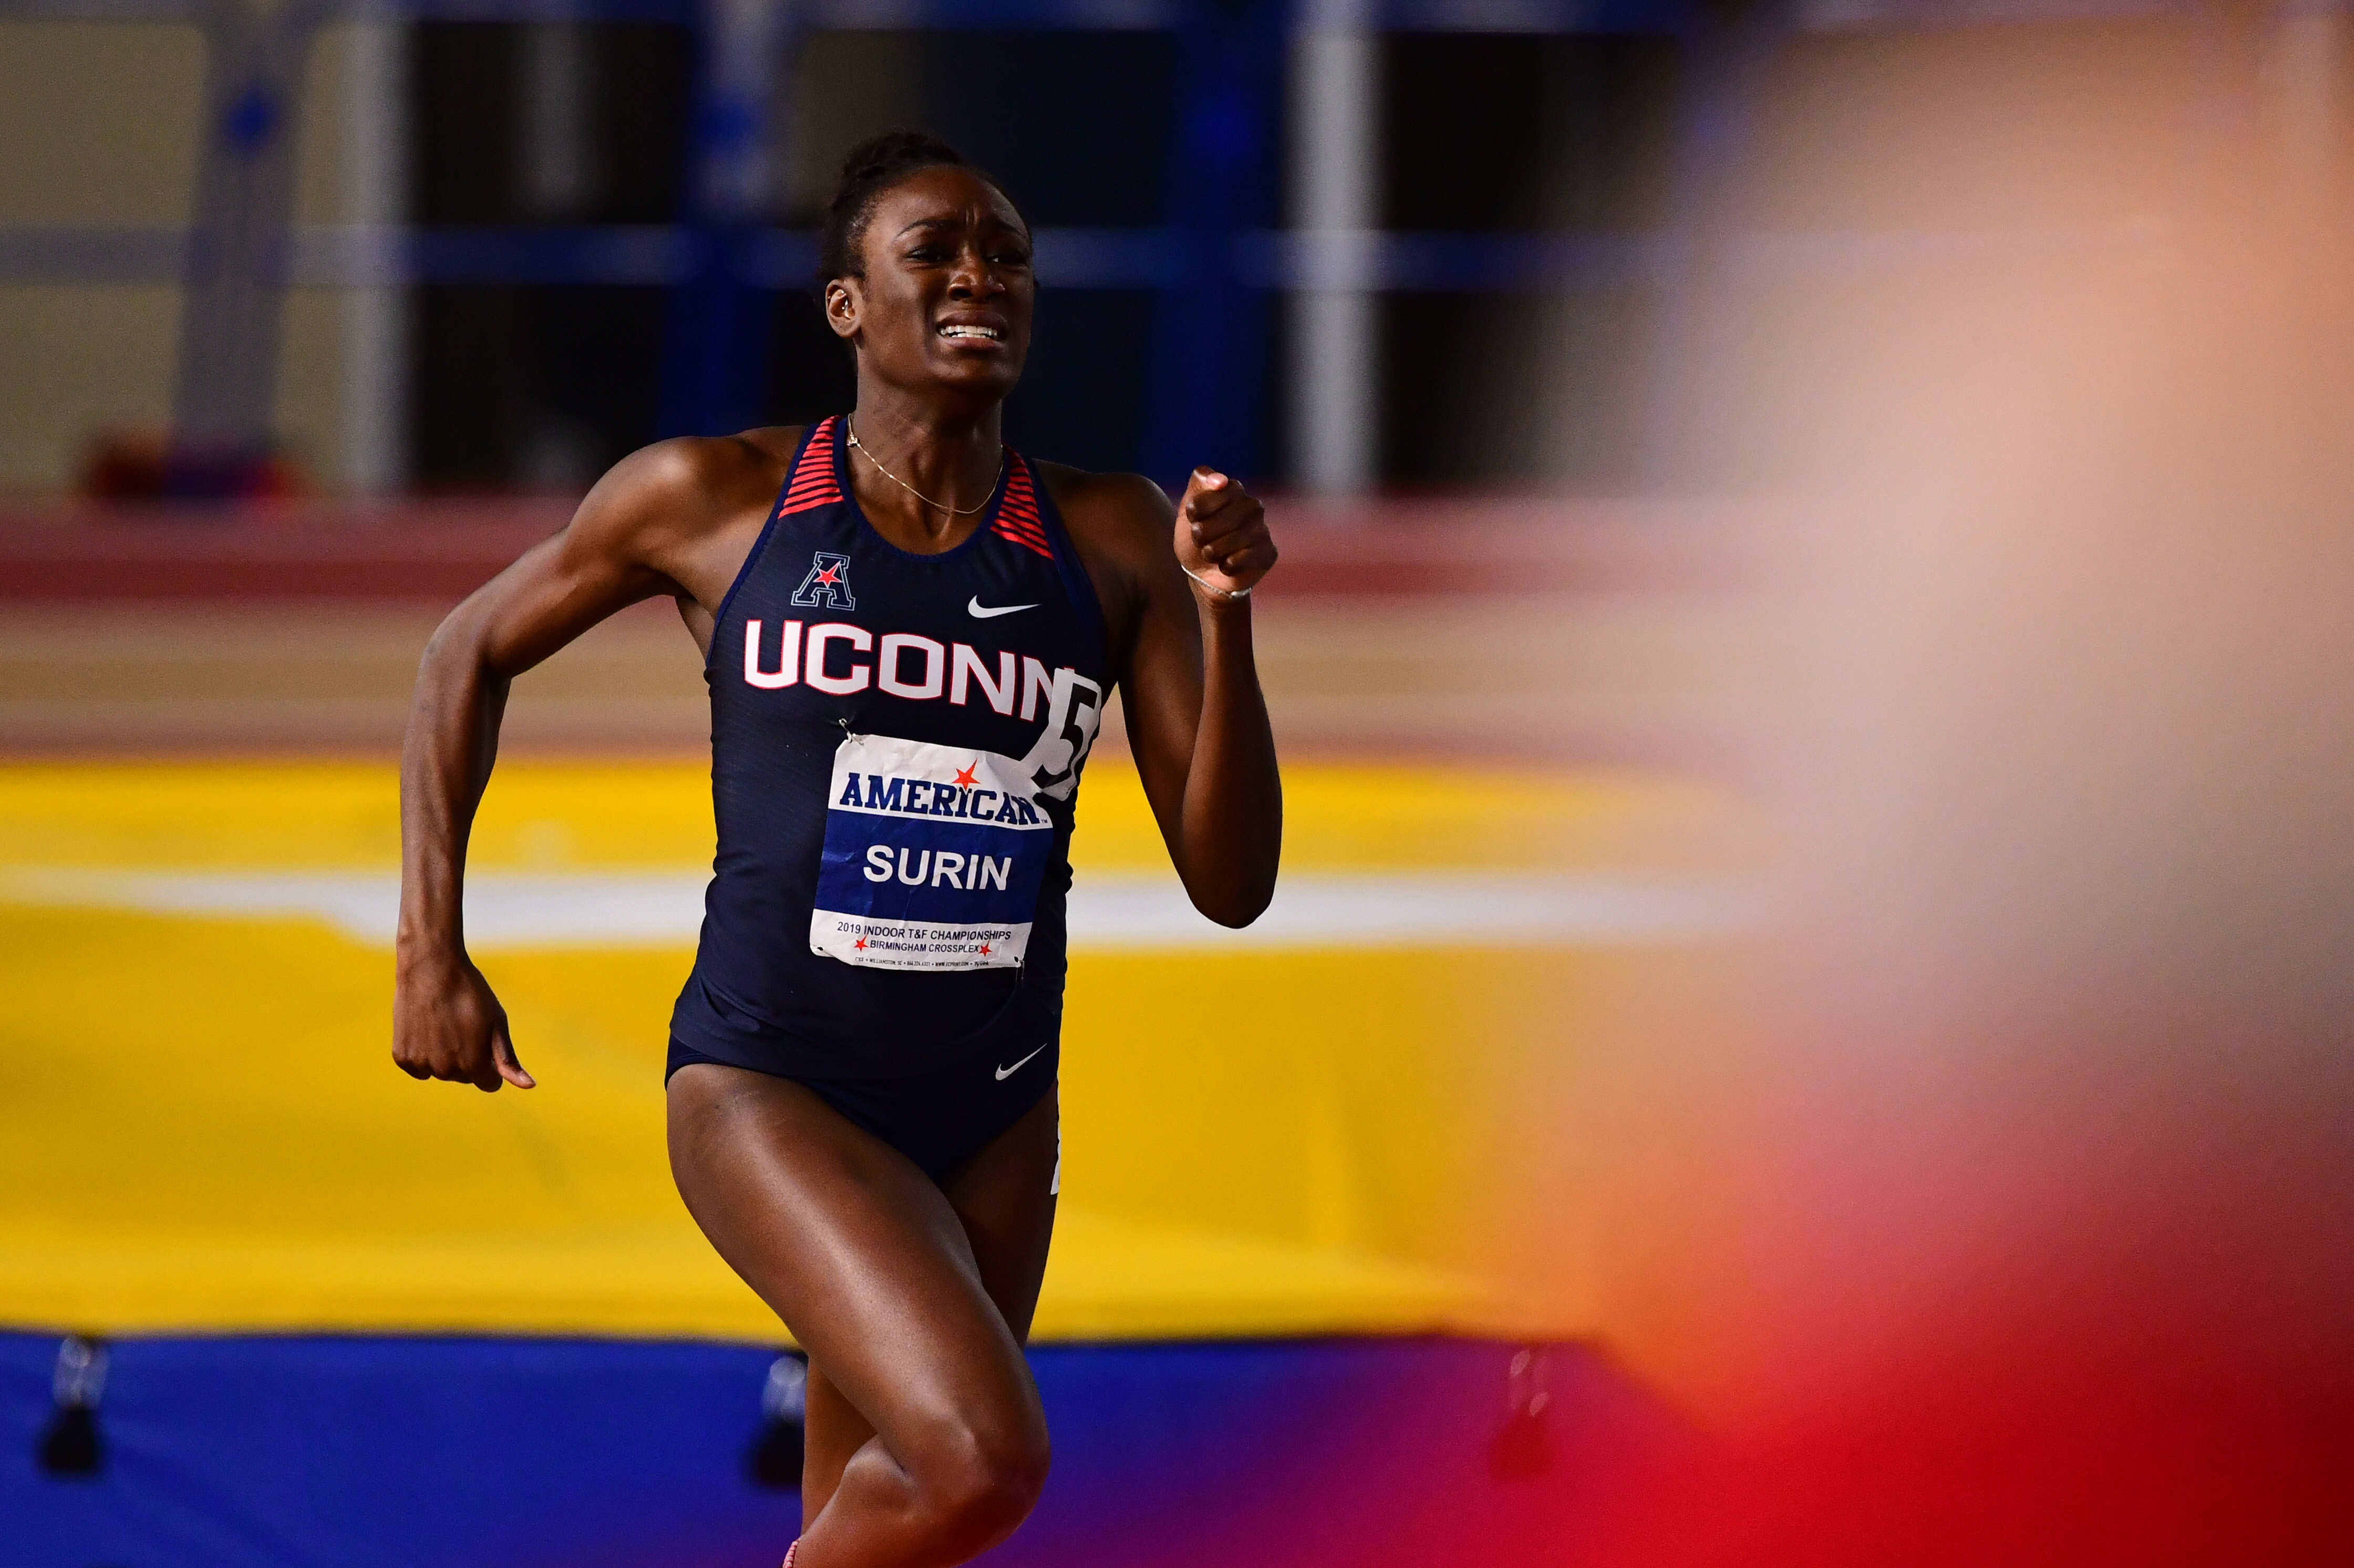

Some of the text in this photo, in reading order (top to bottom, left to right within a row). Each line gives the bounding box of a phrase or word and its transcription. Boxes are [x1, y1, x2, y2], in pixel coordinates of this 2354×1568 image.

[1030, 683, 1098, 789] 5
[840, 772, 1040, 825] AMERICAN
[863, 844, 1012, 891] SURIN
[837, 922, 1011, 940] 2019 INDOOR T&F CHAMPIONSHIPS
[870, 940, 979, 953] BIRMINGHAM CROSSPLEX
